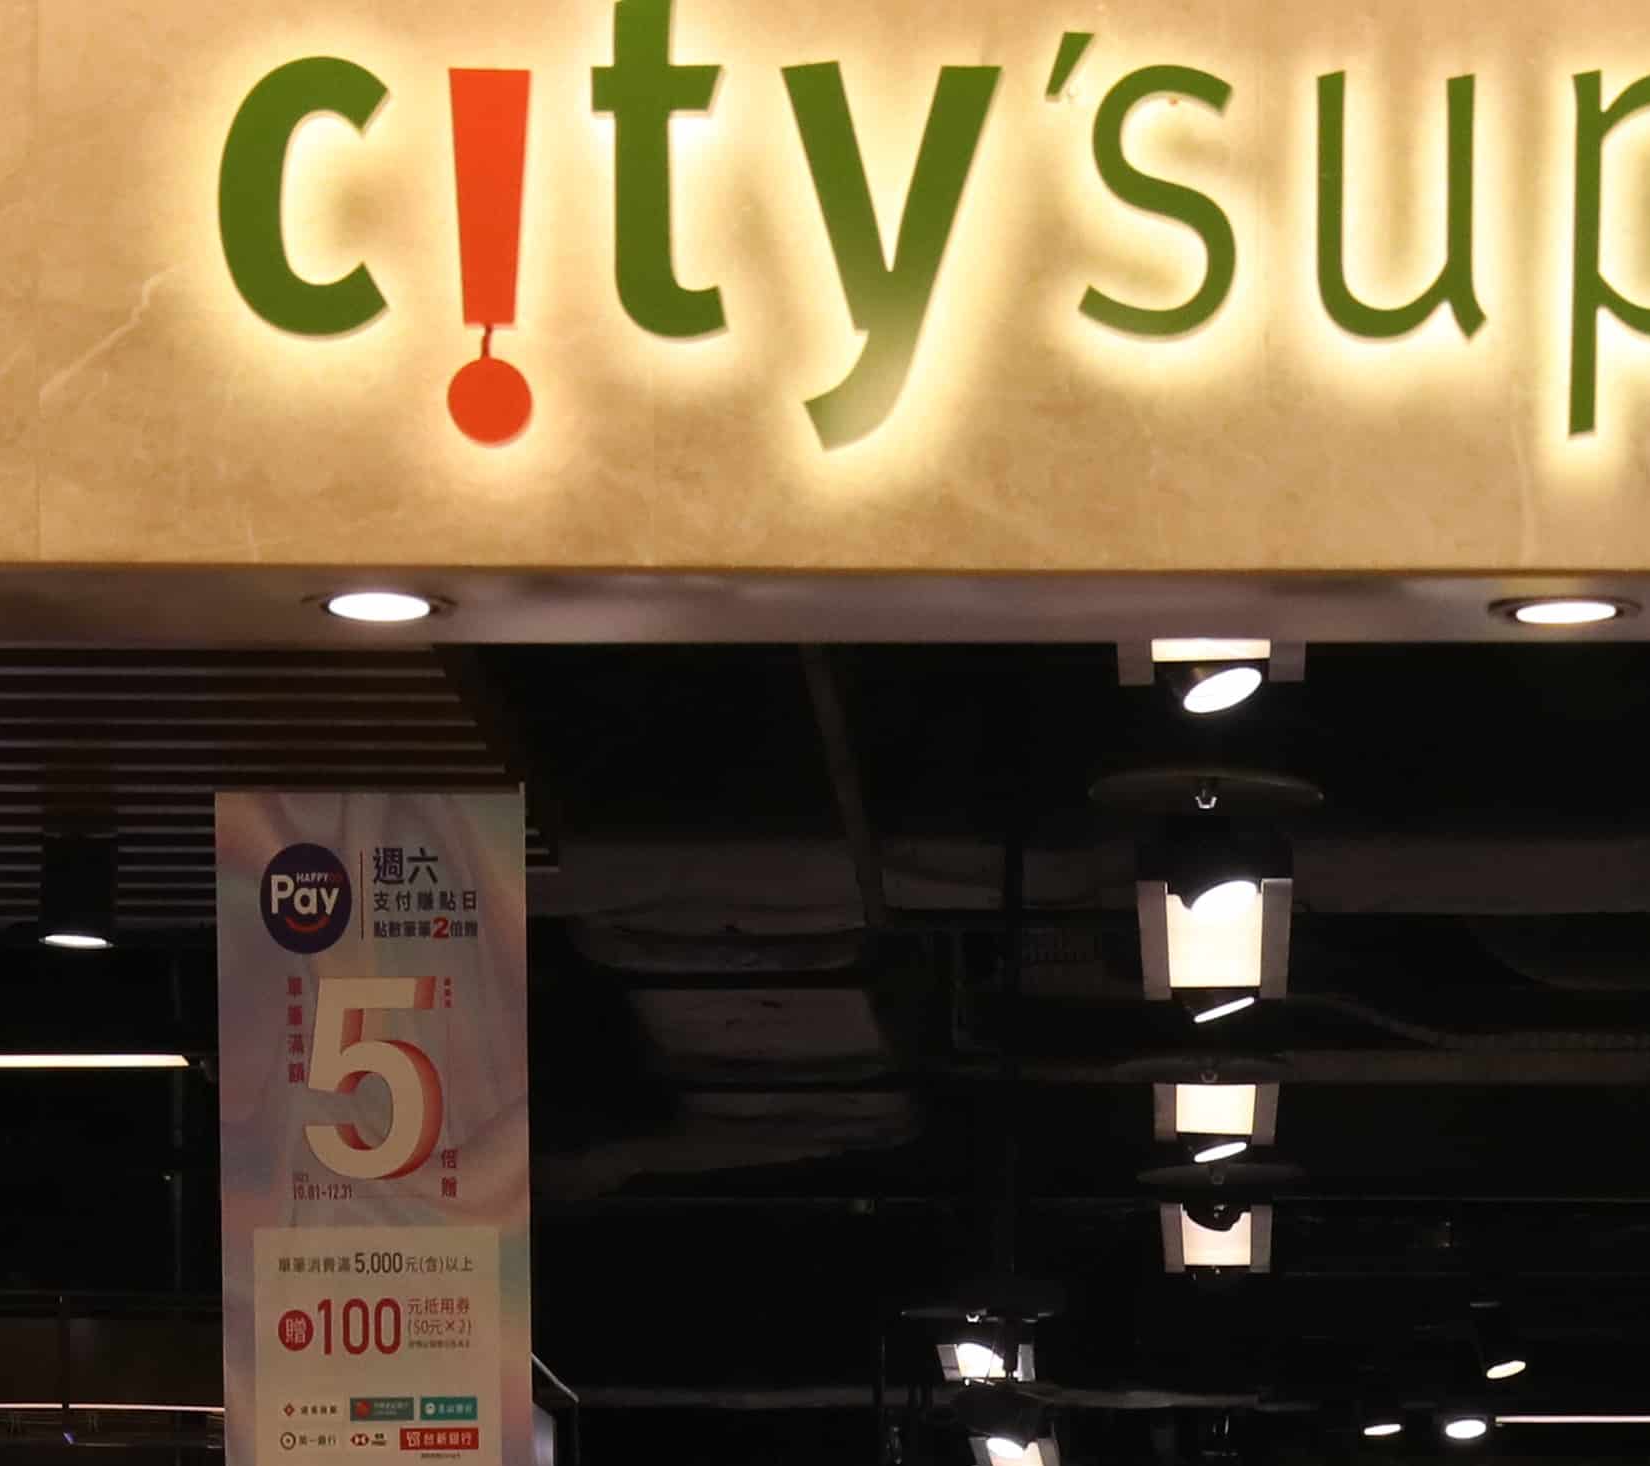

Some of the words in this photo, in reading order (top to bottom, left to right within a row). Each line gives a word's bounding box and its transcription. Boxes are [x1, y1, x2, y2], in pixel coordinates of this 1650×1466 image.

[373, 847, 438, 885] 週六
[270, 874, 340, 917] Pay
[303, 976, 445, 1180] 5
[317, 1297, 402, 1356] 100
